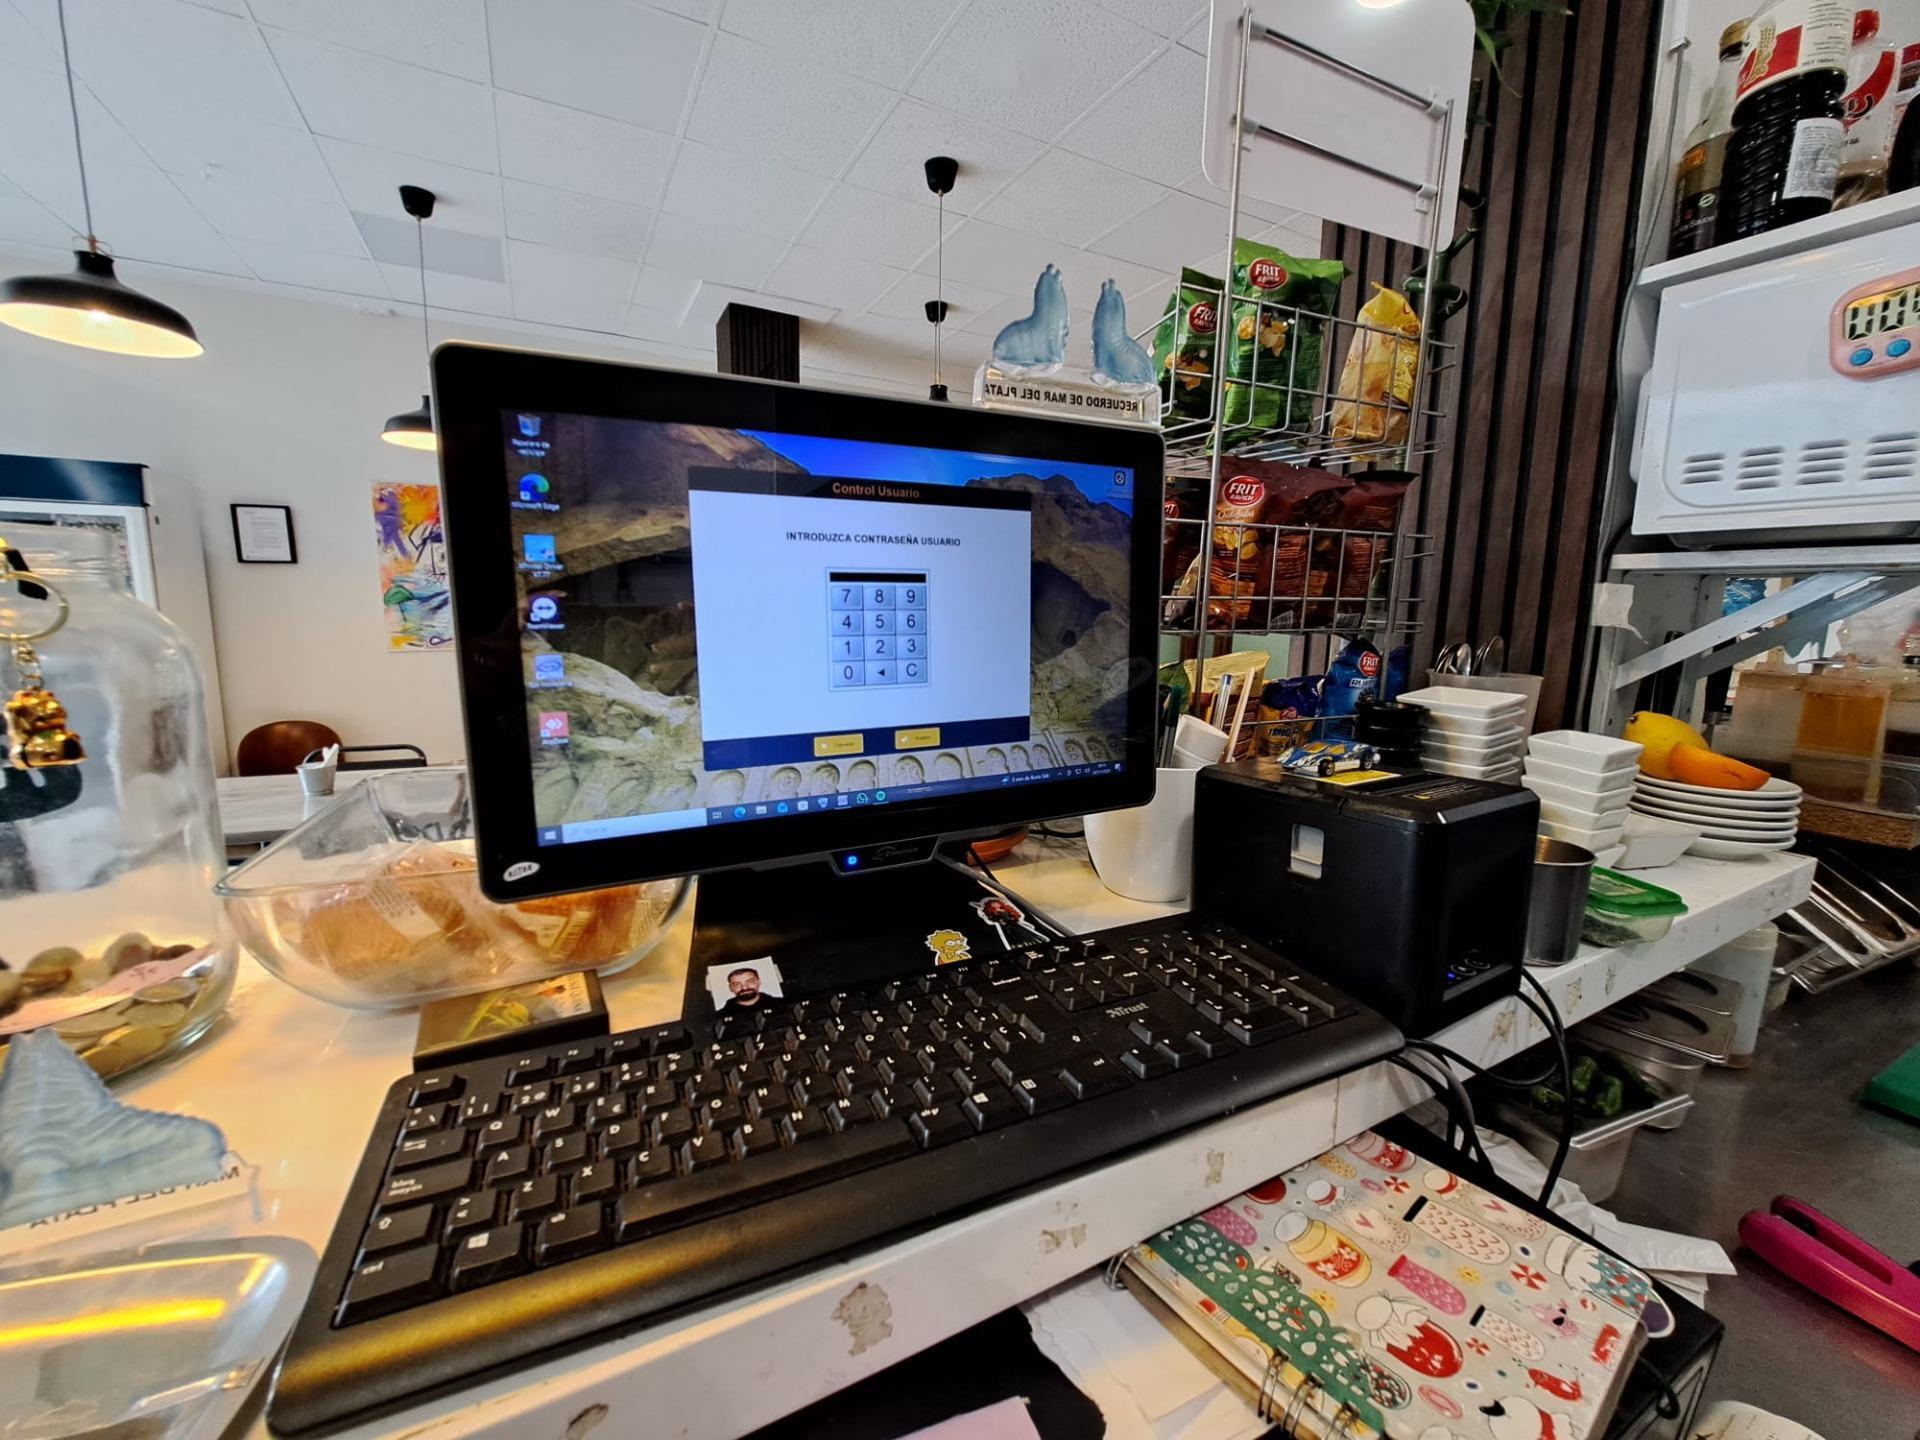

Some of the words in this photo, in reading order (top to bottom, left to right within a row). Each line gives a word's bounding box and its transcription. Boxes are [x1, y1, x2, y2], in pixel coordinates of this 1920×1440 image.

[1255, 263, 1281, 277] FRIT
[832, 482, 875, 496] Control
[878, 486, 920, 499] Usuario
[1229, 482, 1260, 496] FRIT
[786, 531, 852, 543] INTRODUZCA
[854, 534, 919, 545] CONTRASEÑA
[921, 536, 961, 547] USUARIO
[842, 588, 851, 603] 7
[875, 588, 884, 603] 8
[906, 589, 916, 604] 9
[842, 615, 852, 629] 4
[875, 614, 885, 629] 5
[906, 614, 916, 629] 6
[844, 640, 851, 655] 1
[876, 639, 885, 654] 2
[907, 638, 916, 653] 3
[843, 665, 853, 680] 0
[906, 663, 918, 677] C
[1113, 1003, 1149, 1016] Trust
[783, 1053, 791, 1061] U
[845, 1066, 855, 1074] K
[839, 1099, 850, 1108] M
[545, 1107, 560, 1118] W
[791, 1110, 803, 1120] N
[609, 1125, 620, 1134] D
[555, 1138, 564, 1148] S
[693, 1136, 704, 1147] V
[497, 1151, 509, 1161] A
[638, 1151, 650, 1162] C
[582, 1166, 593, 1177] X
[523, 1181, 533, 1193] Z
